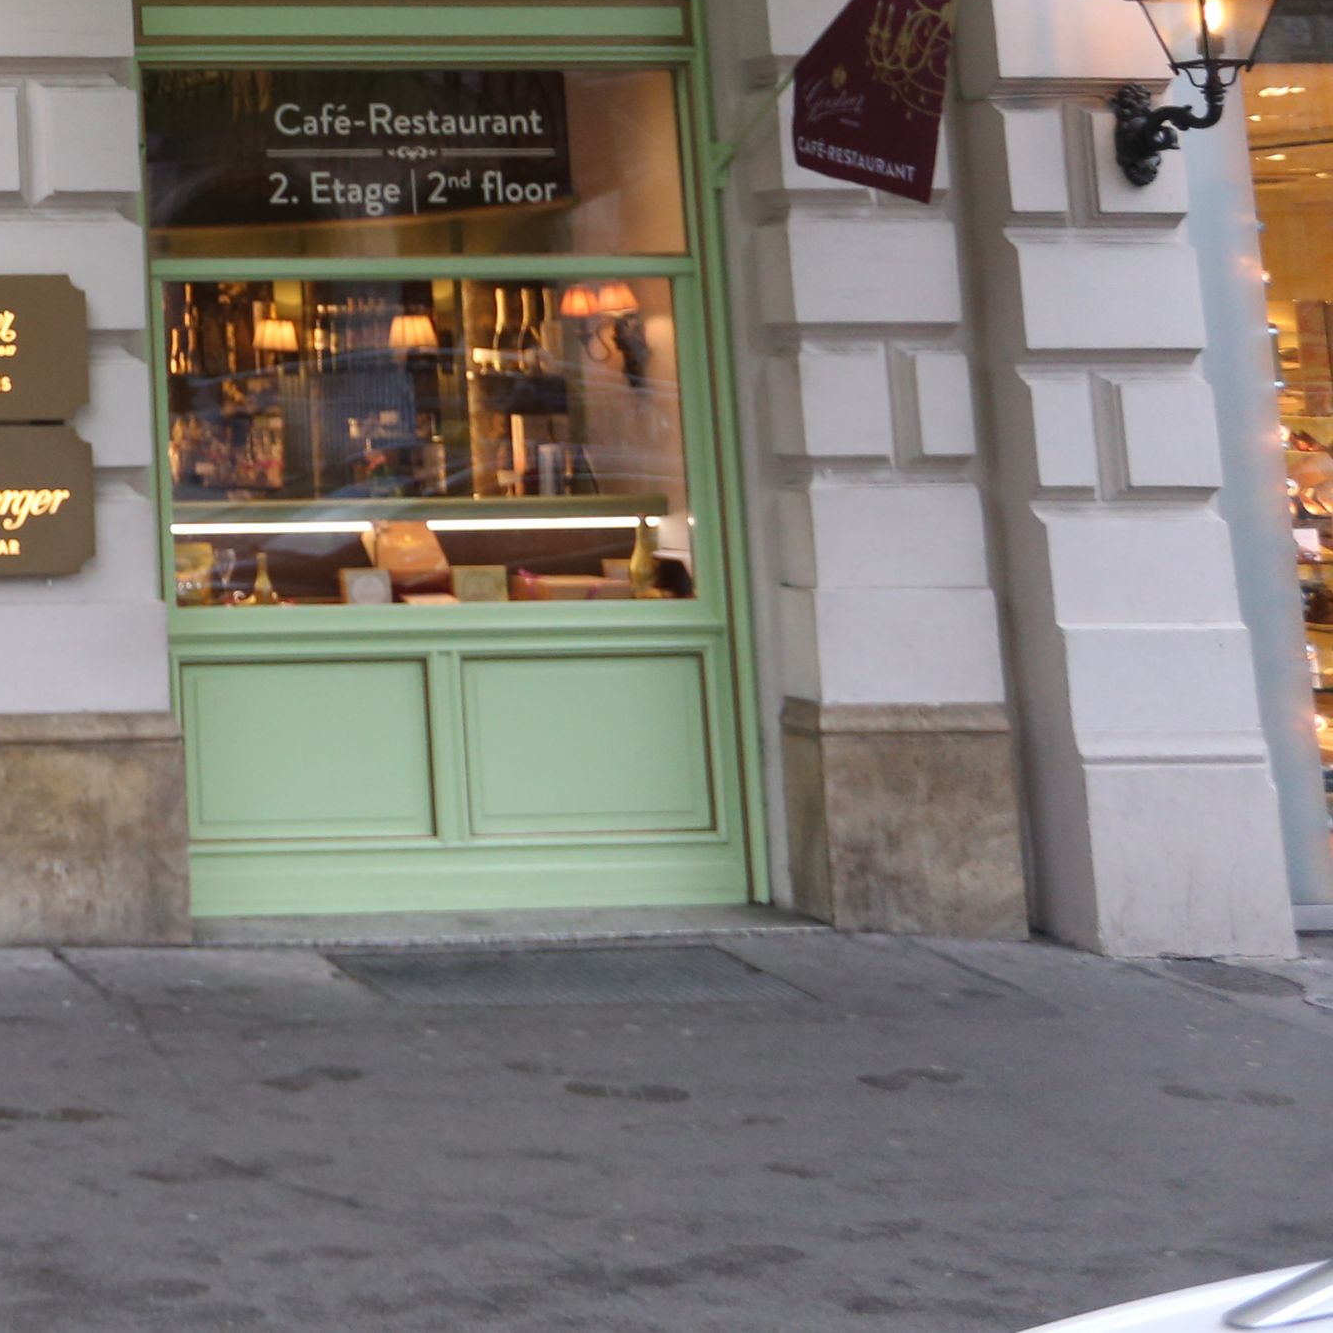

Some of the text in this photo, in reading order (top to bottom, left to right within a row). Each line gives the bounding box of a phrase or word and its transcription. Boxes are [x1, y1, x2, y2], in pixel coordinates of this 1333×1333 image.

[274, 103, 544, 135] Café-Restaurant
[796, 136, 916, 182] CAFÉ-RESTAURANT
[268, 169, 557, 215] 2. Etage 2nd floor
